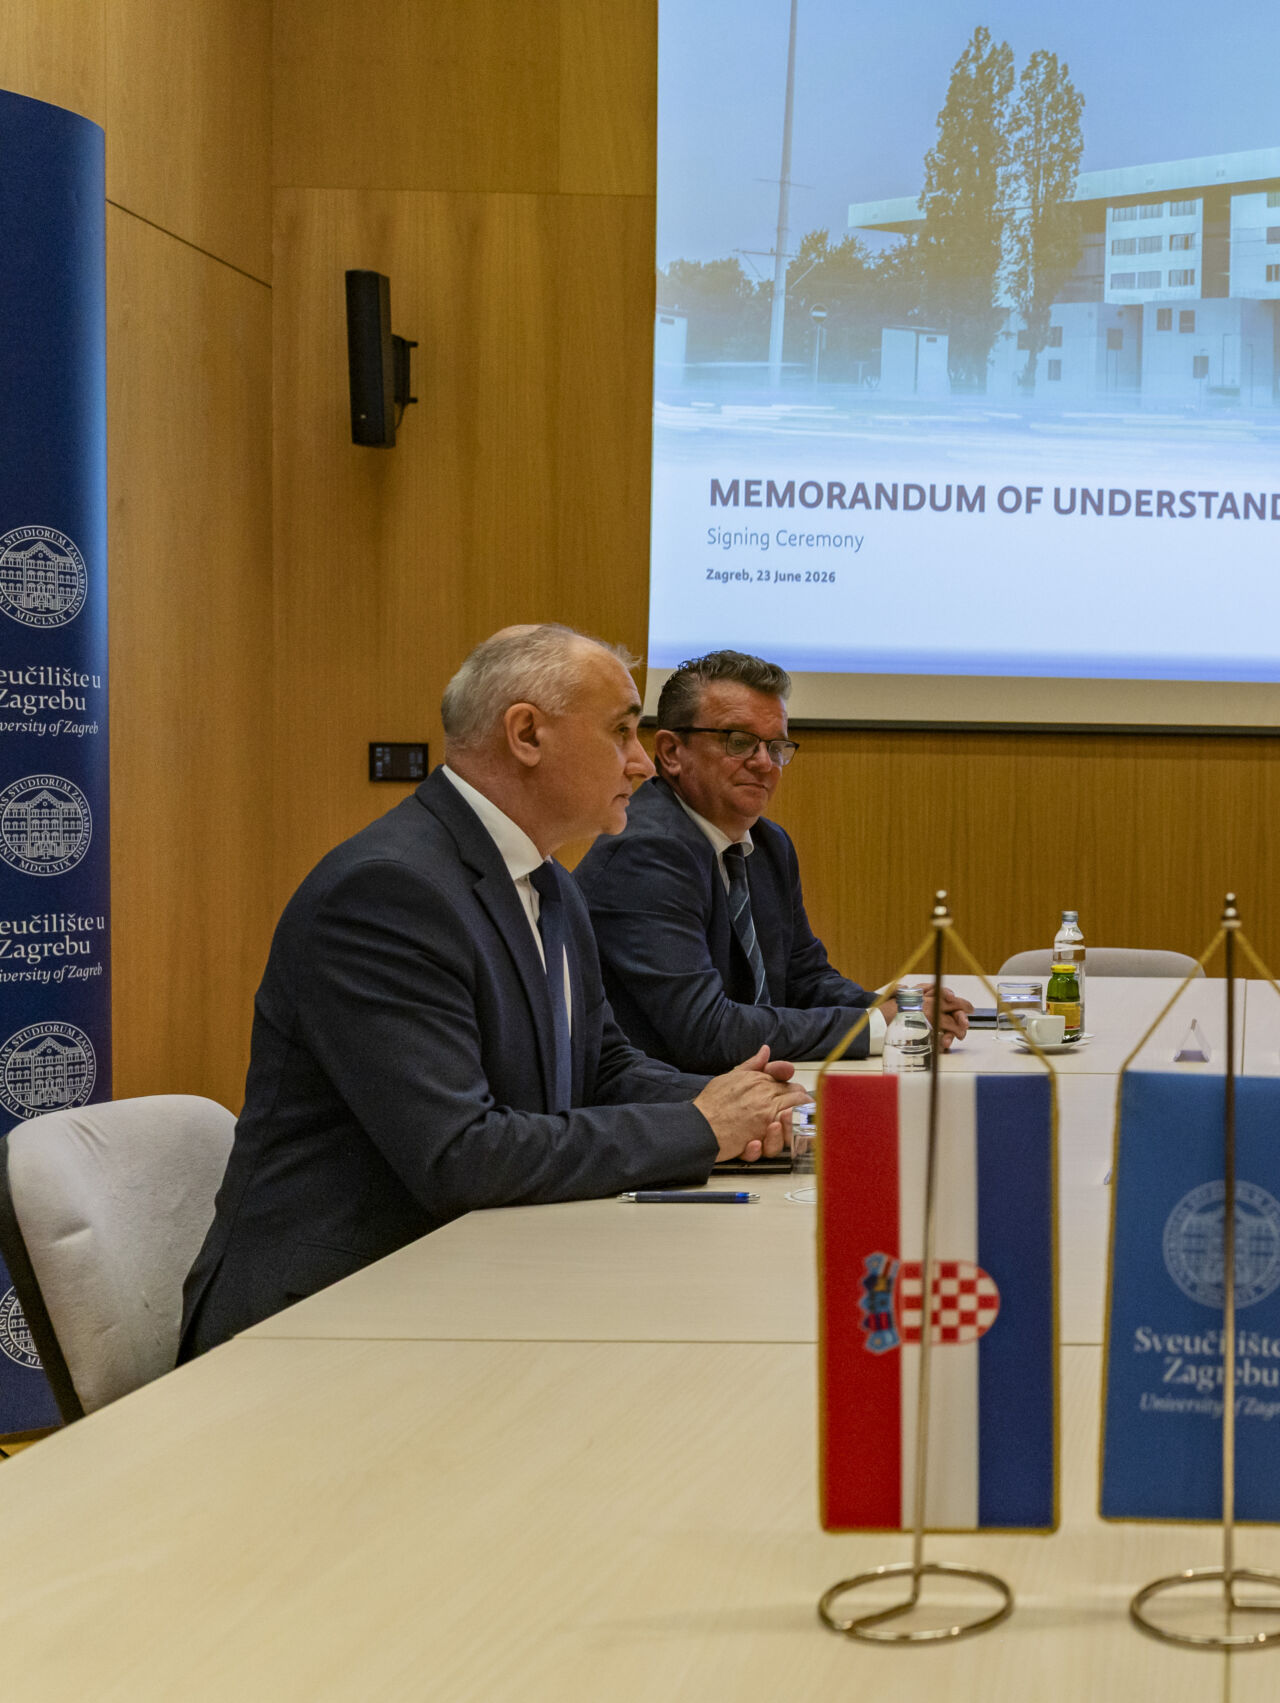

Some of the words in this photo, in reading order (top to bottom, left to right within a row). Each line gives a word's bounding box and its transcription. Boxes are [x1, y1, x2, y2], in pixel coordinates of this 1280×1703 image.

[709, 478, 986, 513] MEMORANDUM
[997, 485, 1043, 514] OF
[4, 528, 67, 546] STUDIORUM
[706, 526, 770, 550] Signing
[776, 529, 864, 553] Ceremony
[705, 568, 753, 583] Zagreb,
[757, 570, 771, 582] 23
[773, 570, 801, 583] June
[804, 571, 836, 583] 2026
[15, 610, 67, 625] MDCLXIX
[0, 665, 90, 688] eučilište
[92, 675, 101, 689] u
[0, 688, 87, 716] Zagrebu
[0, 718, 47, 737] versity
[48, 719, 64, 737] of
[63, 720, 99, 738] Zagreb
[8, 777, 71, 797] STUDIORUM
[19, 859, 72, 873] MDCLXIX
[0, 913, 94, 935] eučilište
[96, 916, 105, 930] u
[0, 934, 91, 965] Zagrebu
[0, 967, 51, 985] iversity
[53, 965, 68, 984] of
[67, 961, 103, 981] Zagreb
[11, 1024, 76, 1047] STUDIORUM
